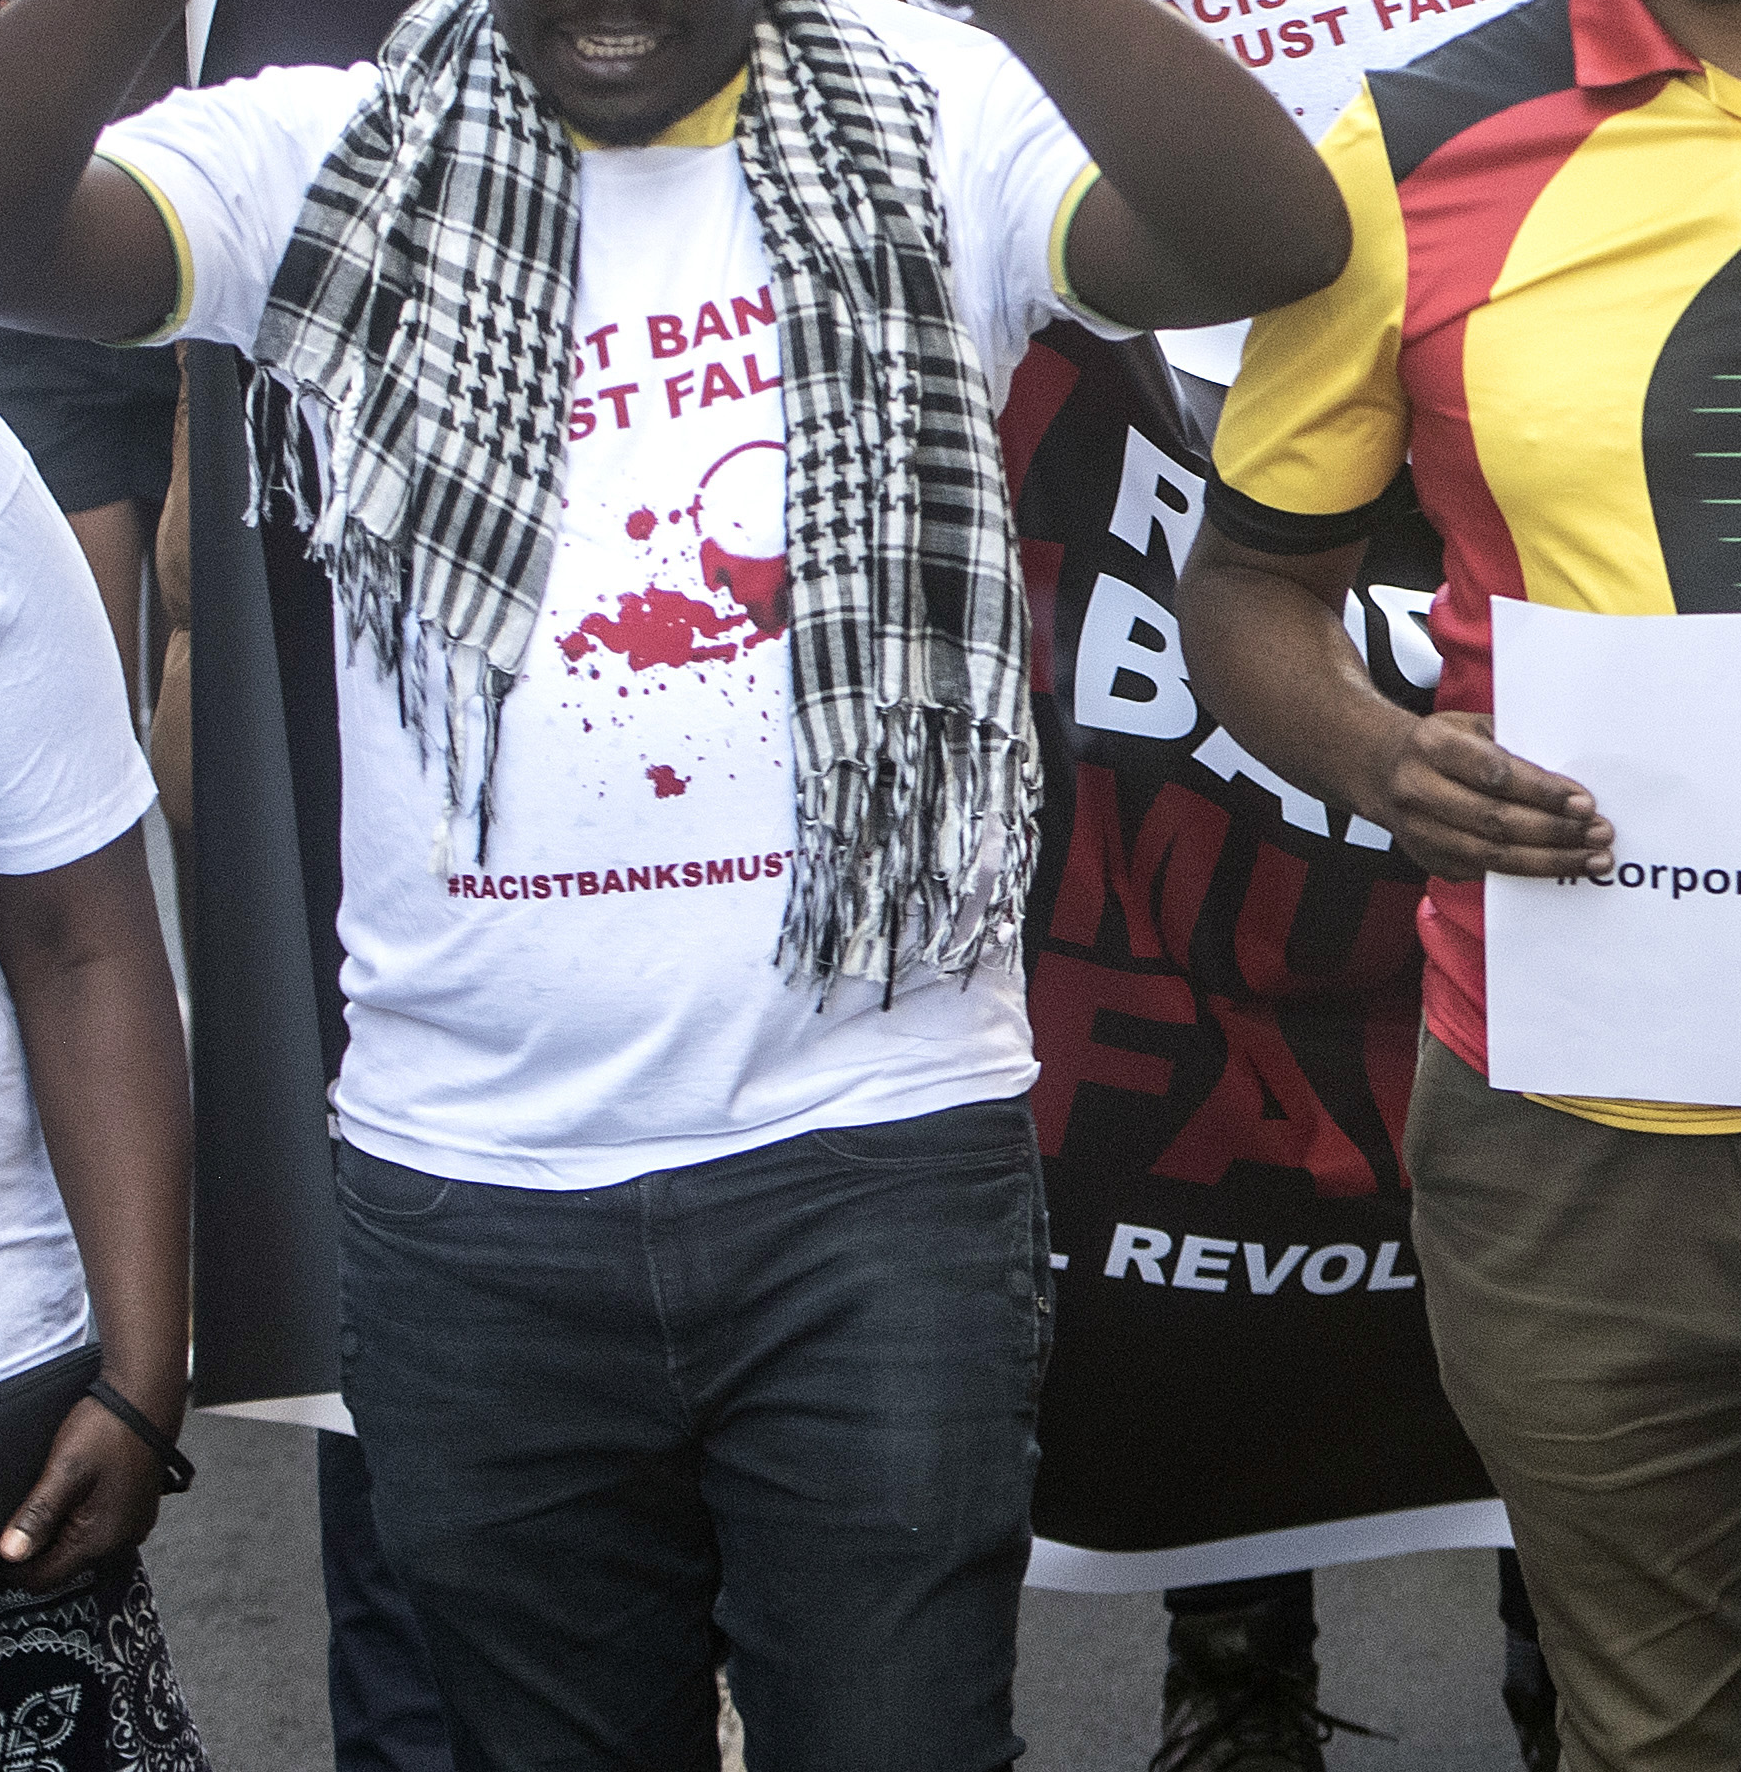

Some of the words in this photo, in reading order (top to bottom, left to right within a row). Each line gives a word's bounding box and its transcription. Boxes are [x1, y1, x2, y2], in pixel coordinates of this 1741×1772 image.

[1227, 5, 1349, 69] UST
[646, 283, 777, 360] BAN
[567, 381, 640, 443] ST
[663, 353, 784, 420] FAL
[446, 848, 795, 902] #RACISTBANKSMUS
[1104, 1222, 1418, 1297] REVOL
